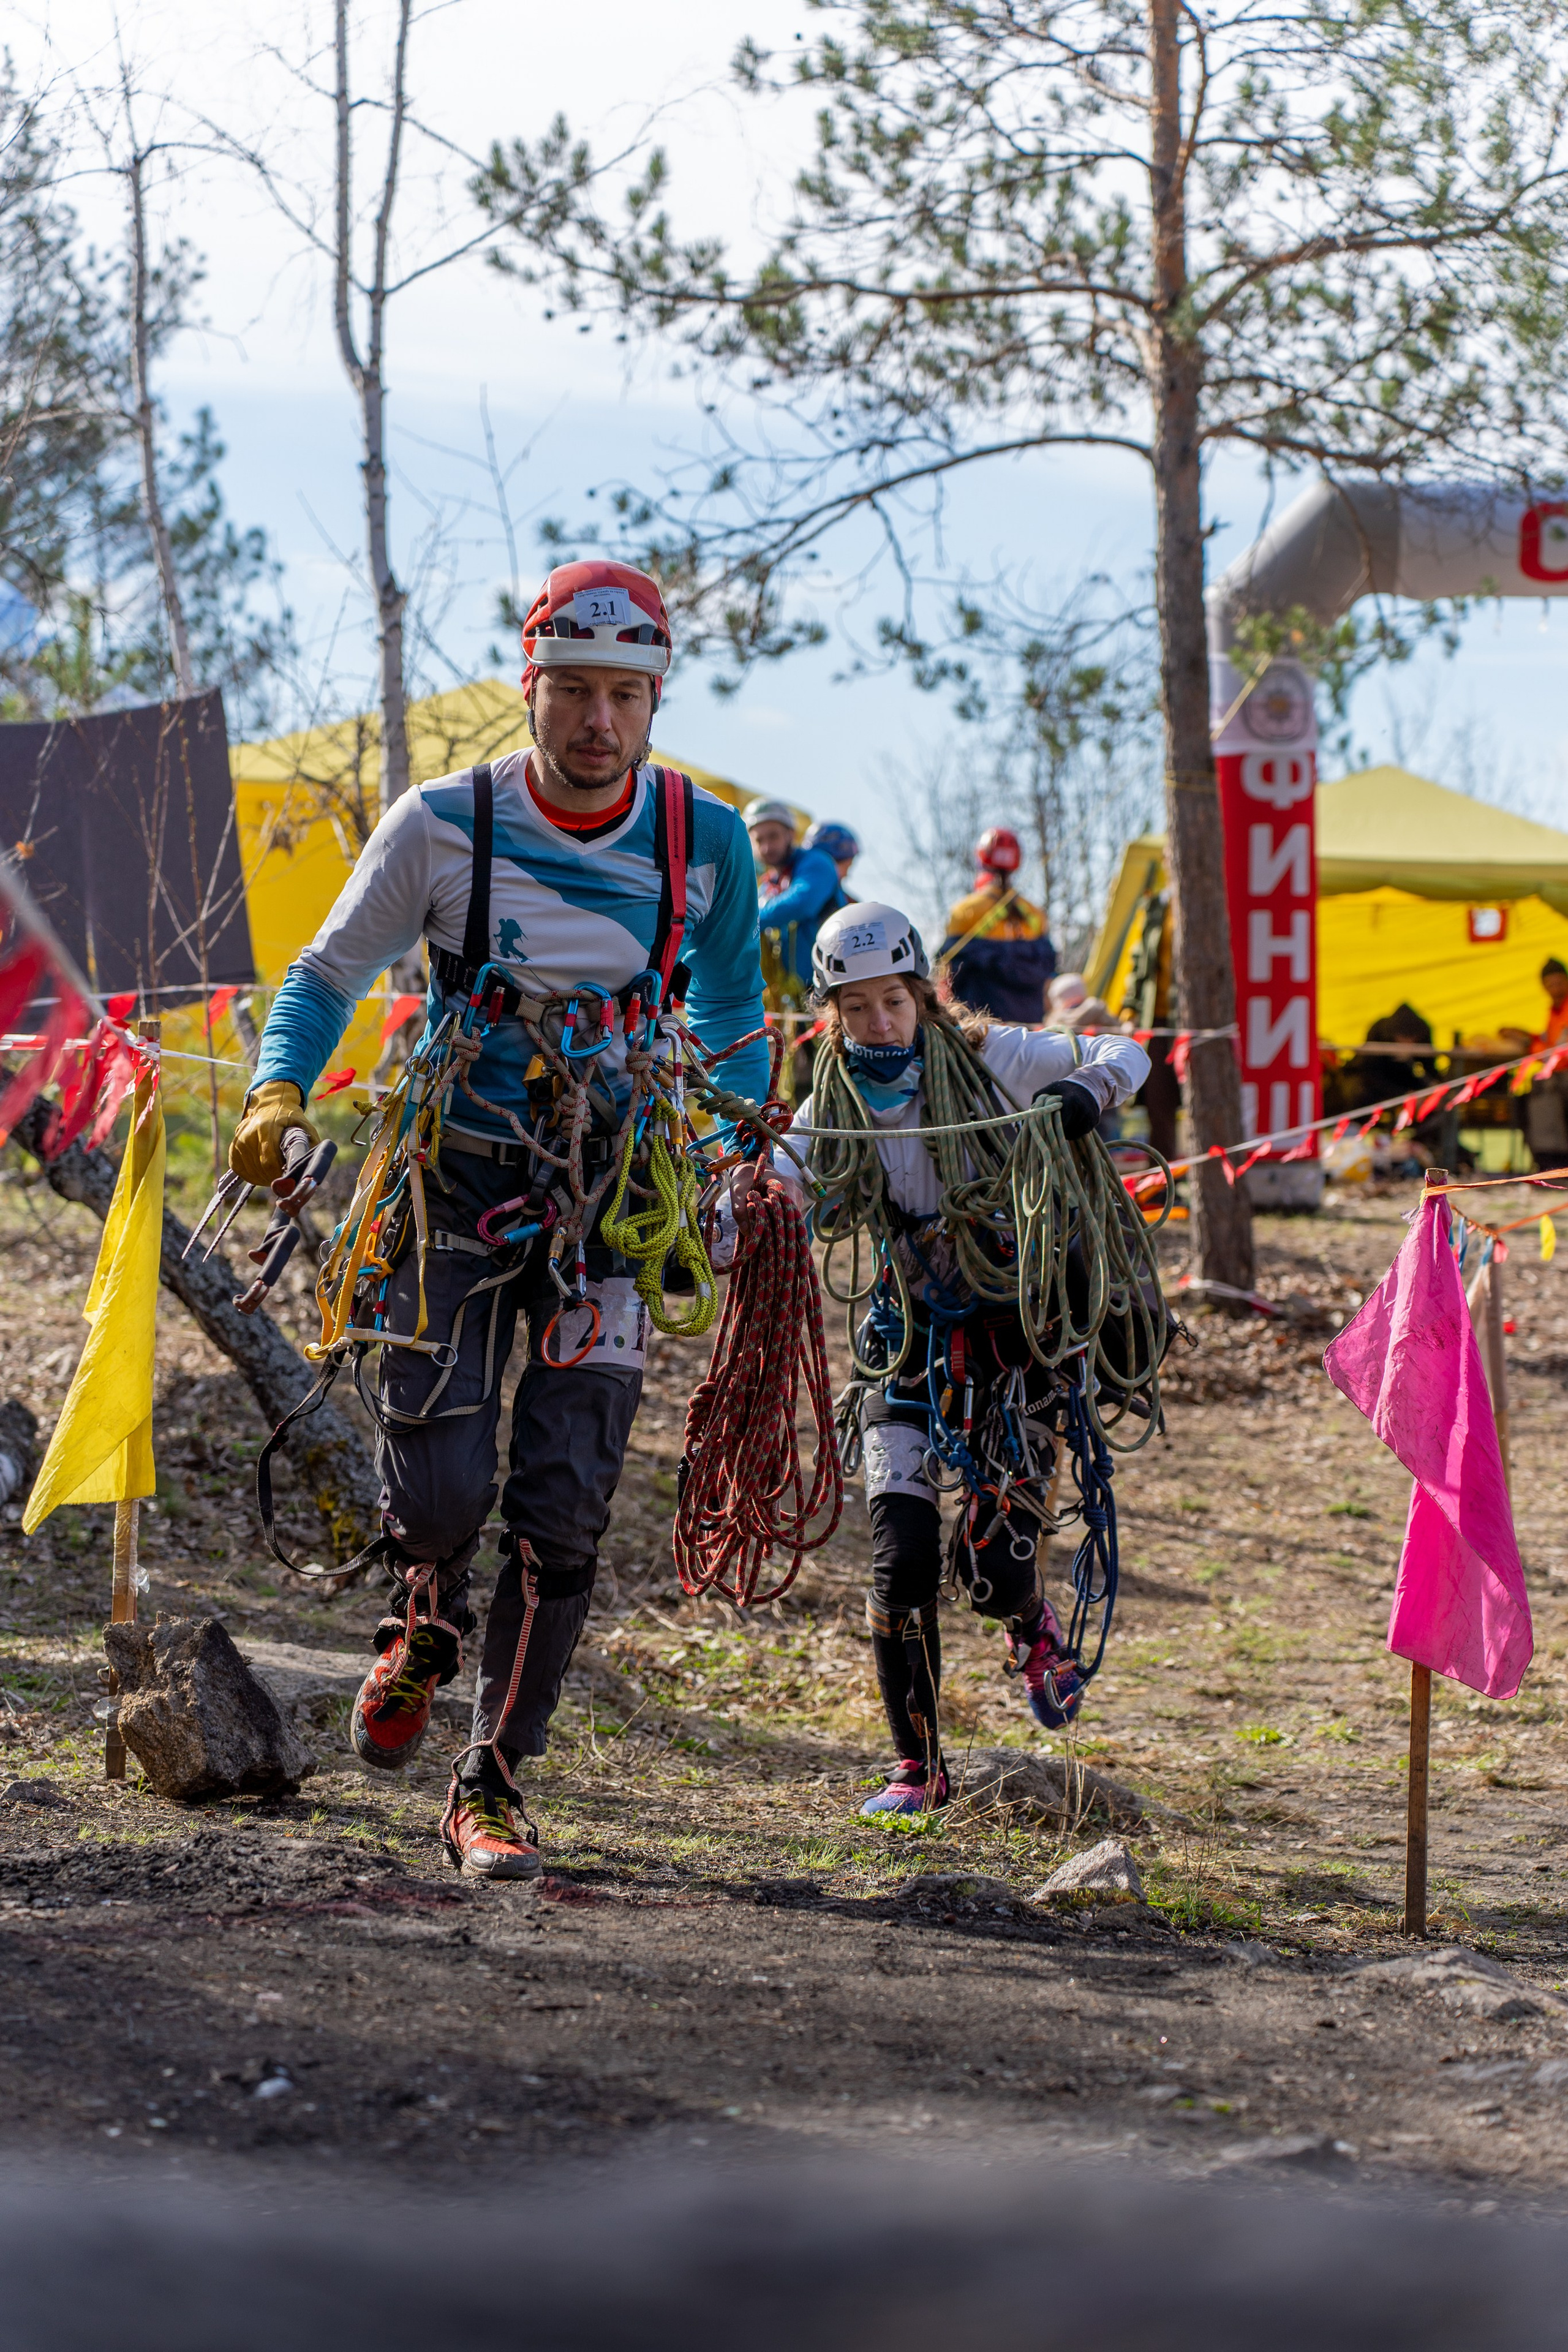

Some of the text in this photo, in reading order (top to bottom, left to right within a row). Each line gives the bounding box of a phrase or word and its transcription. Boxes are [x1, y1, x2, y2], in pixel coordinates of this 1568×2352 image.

[590, 601, 617, 617] 2.1
[851, 933, 875, 948] 2.2
[1240, 753, 1314, 1152] ФИНИШ
[573, 1298, 645, 1352] 2.1
